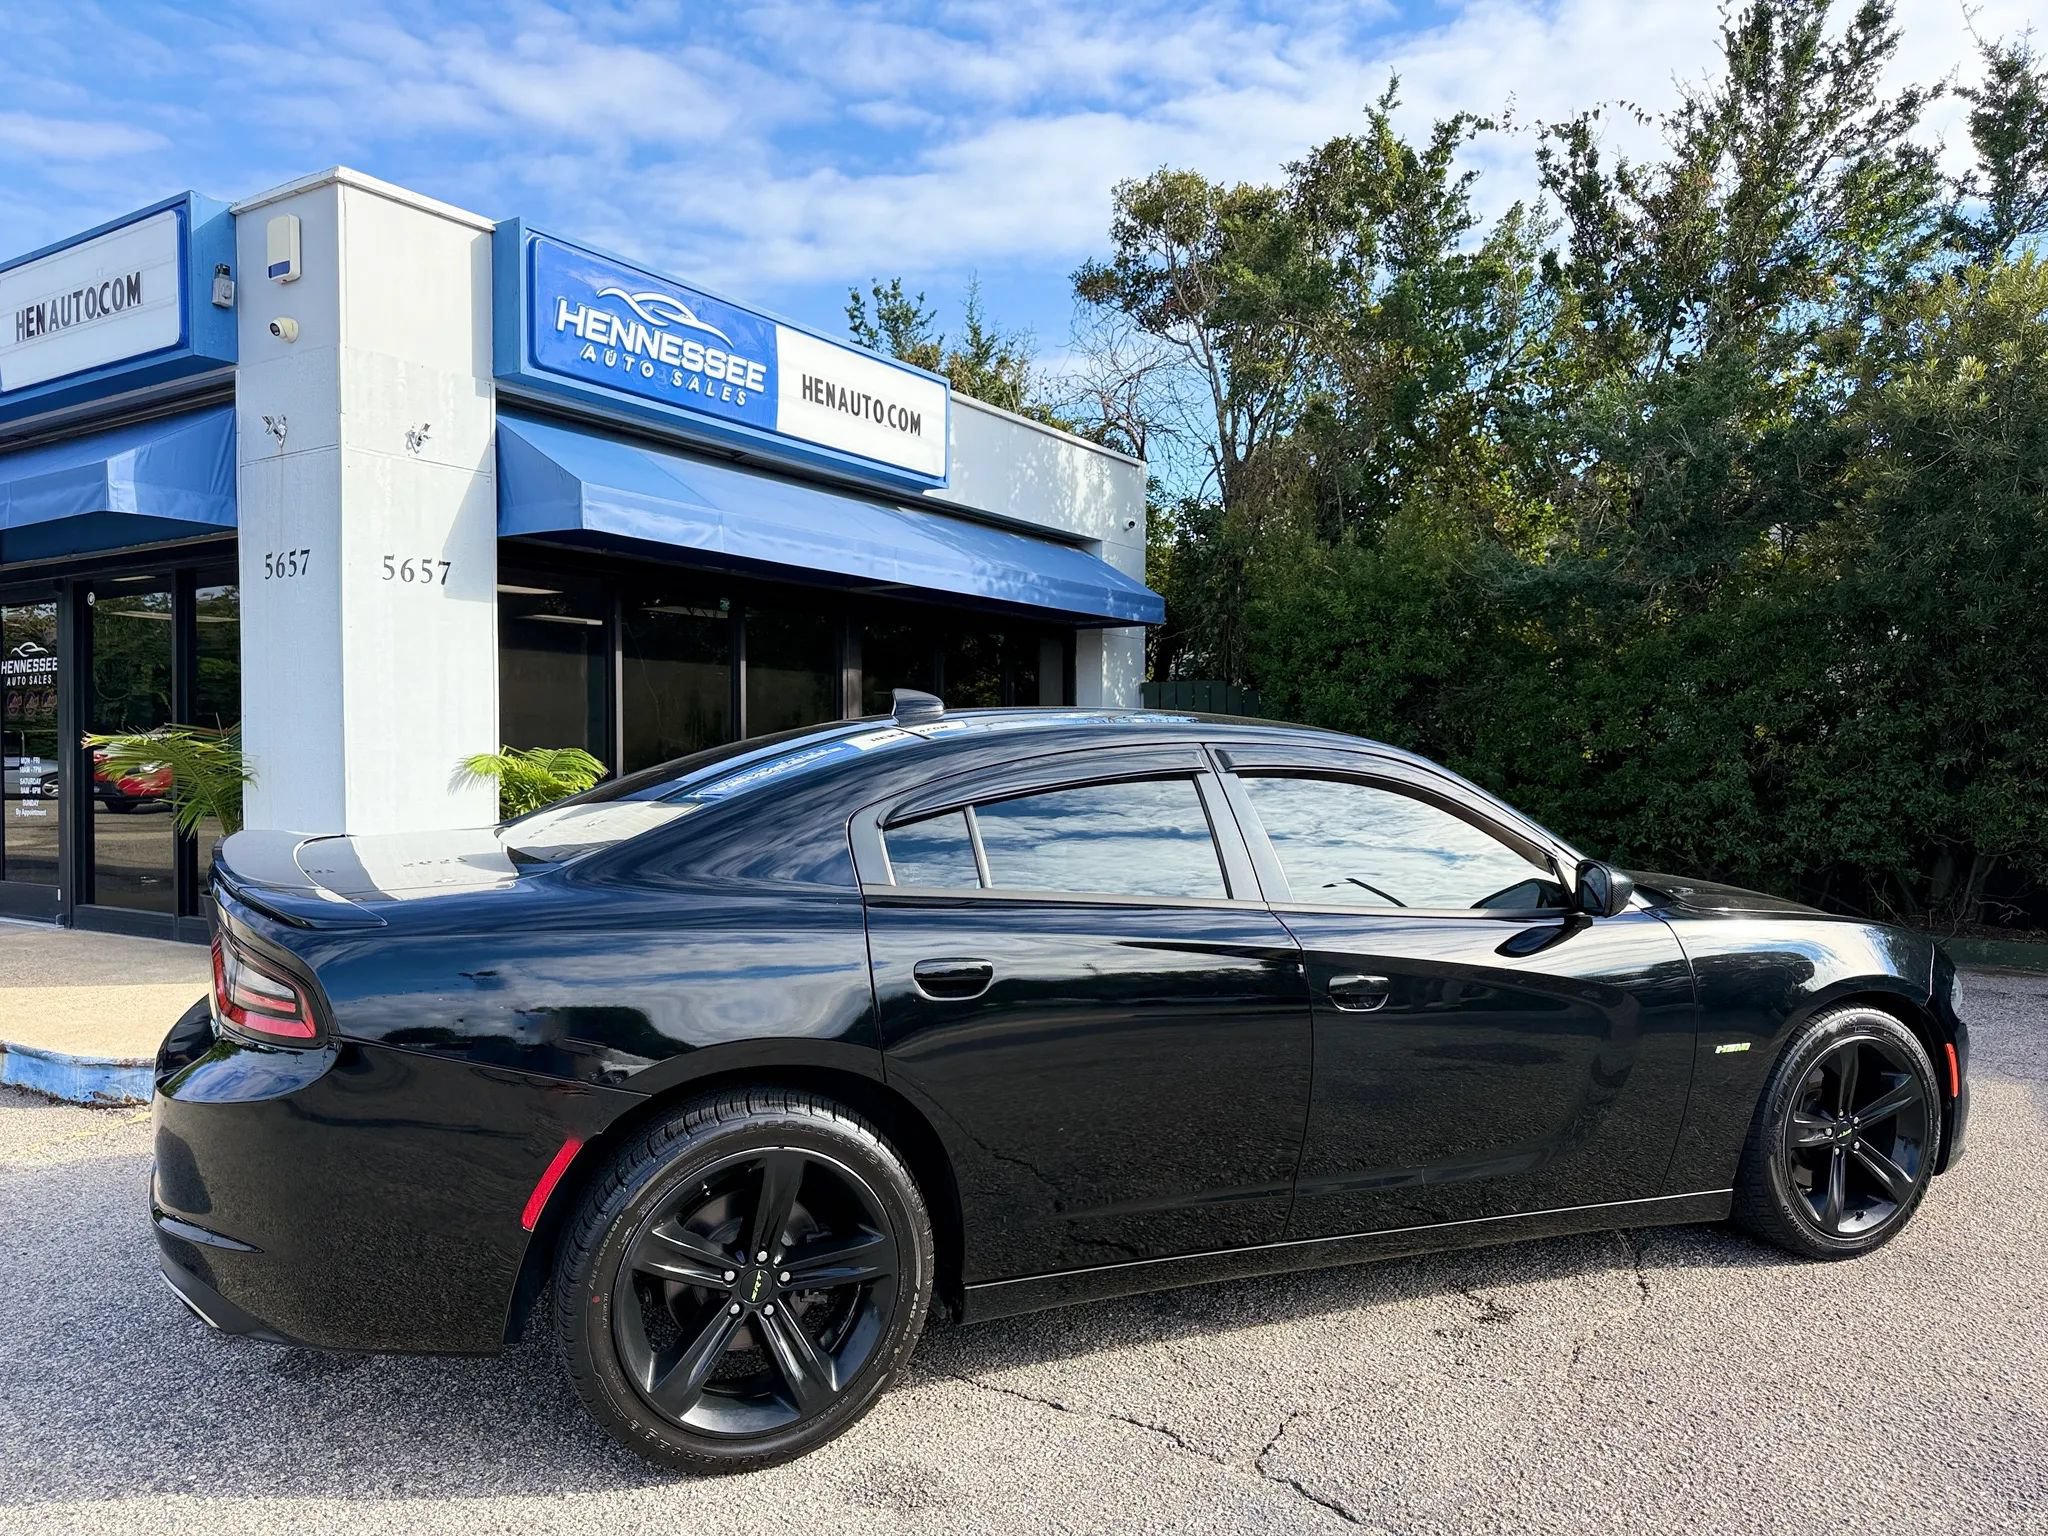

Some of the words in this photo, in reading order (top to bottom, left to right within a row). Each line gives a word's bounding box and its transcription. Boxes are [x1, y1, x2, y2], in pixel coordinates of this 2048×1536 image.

[16, 271, 142, 342] HENAUTO.COM
[556, 297, 768, 393] HENNESSEE
[580, 343, 655, 378] AUTO
[671, 369, 747, 406] SALES
[264, 549, 311, 580] 5657
[382, 554, 452, 586] 5657
[1, 657, 58, 675] HENNESSEE
[7, 676, 27, 687] AUTO
[29, 674, 52, 686] SALES
[20, 777, 42, 785] SATURDAY
[22, 799, 40, 807] SUNDAY
